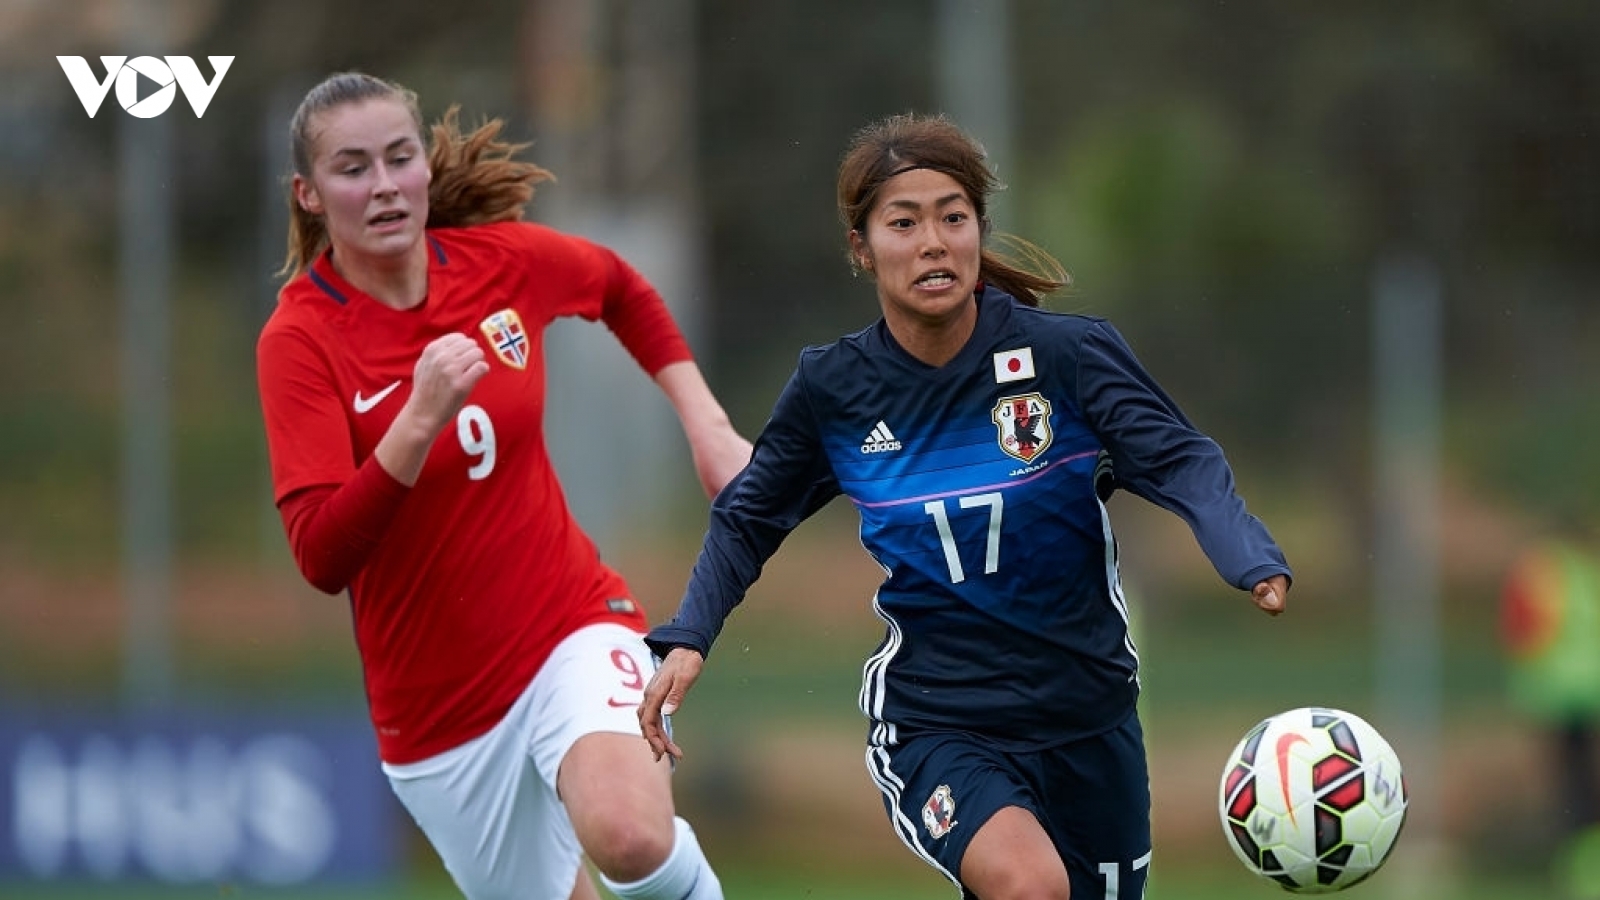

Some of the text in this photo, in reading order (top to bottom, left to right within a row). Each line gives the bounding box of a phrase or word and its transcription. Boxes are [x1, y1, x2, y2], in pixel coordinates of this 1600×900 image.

[1002, 401, 1041, 418] JFA
[457, 404, 497, 481] 9
[860, 440, 902, 454] adidas
[1008, 460, 1048, 476] JAPAN
[924, 492, 1004, 584] 17
[610, 649, 643, 691] 9
[1098, 848, 1152, 900] 1
